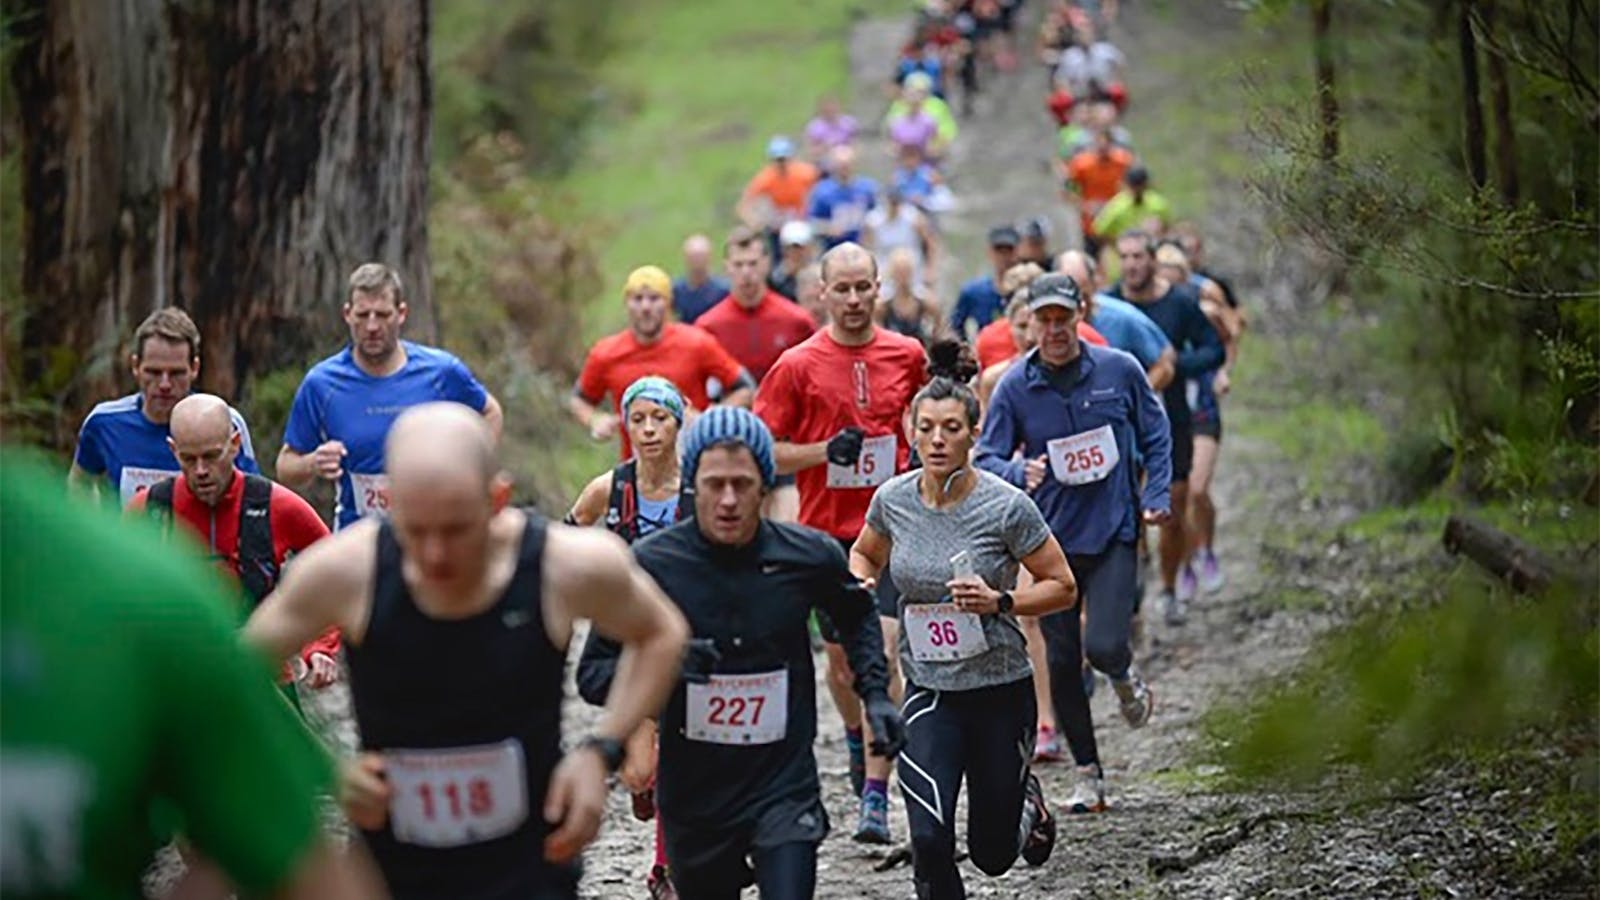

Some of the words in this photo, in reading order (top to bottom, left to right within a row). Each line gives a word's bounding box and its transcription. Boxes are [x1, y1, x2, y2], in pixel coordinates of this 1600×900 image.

[1064, 445, 1105, 474] 255
[928, 620, 959, 647] 36
[708, 696, 766, 725] 227
[416, 775, 496, 823] 118
